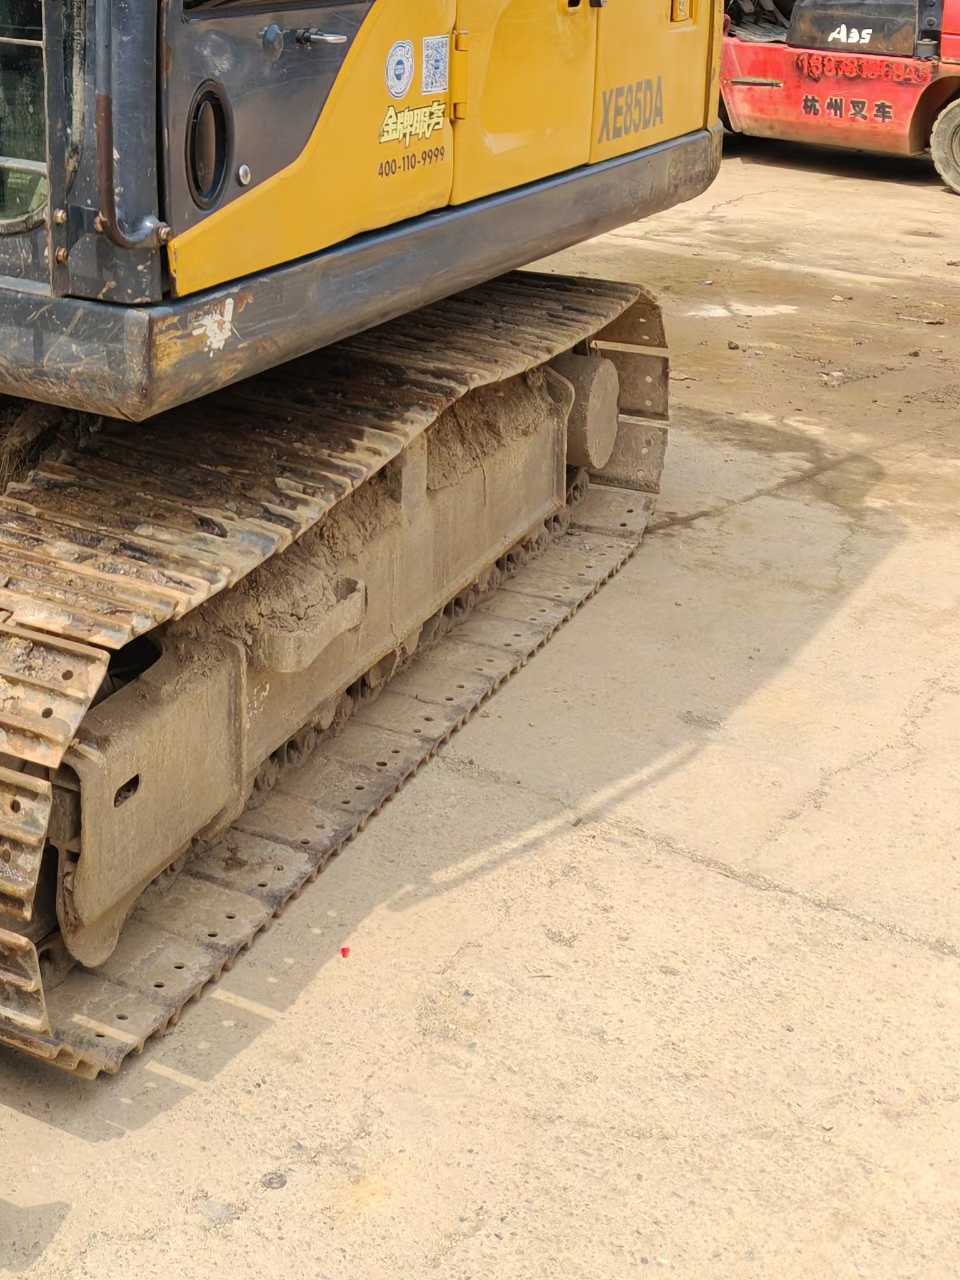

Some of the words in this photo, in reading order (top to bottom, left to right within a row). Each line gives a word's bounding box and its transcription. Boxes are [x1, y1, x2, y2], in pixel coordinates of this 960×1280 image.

[597, 76, 665, 145] XE85DA
[802, 94, 893, 122] 杭州叉车
[377, 145, 446, 179] 400-110-9999
